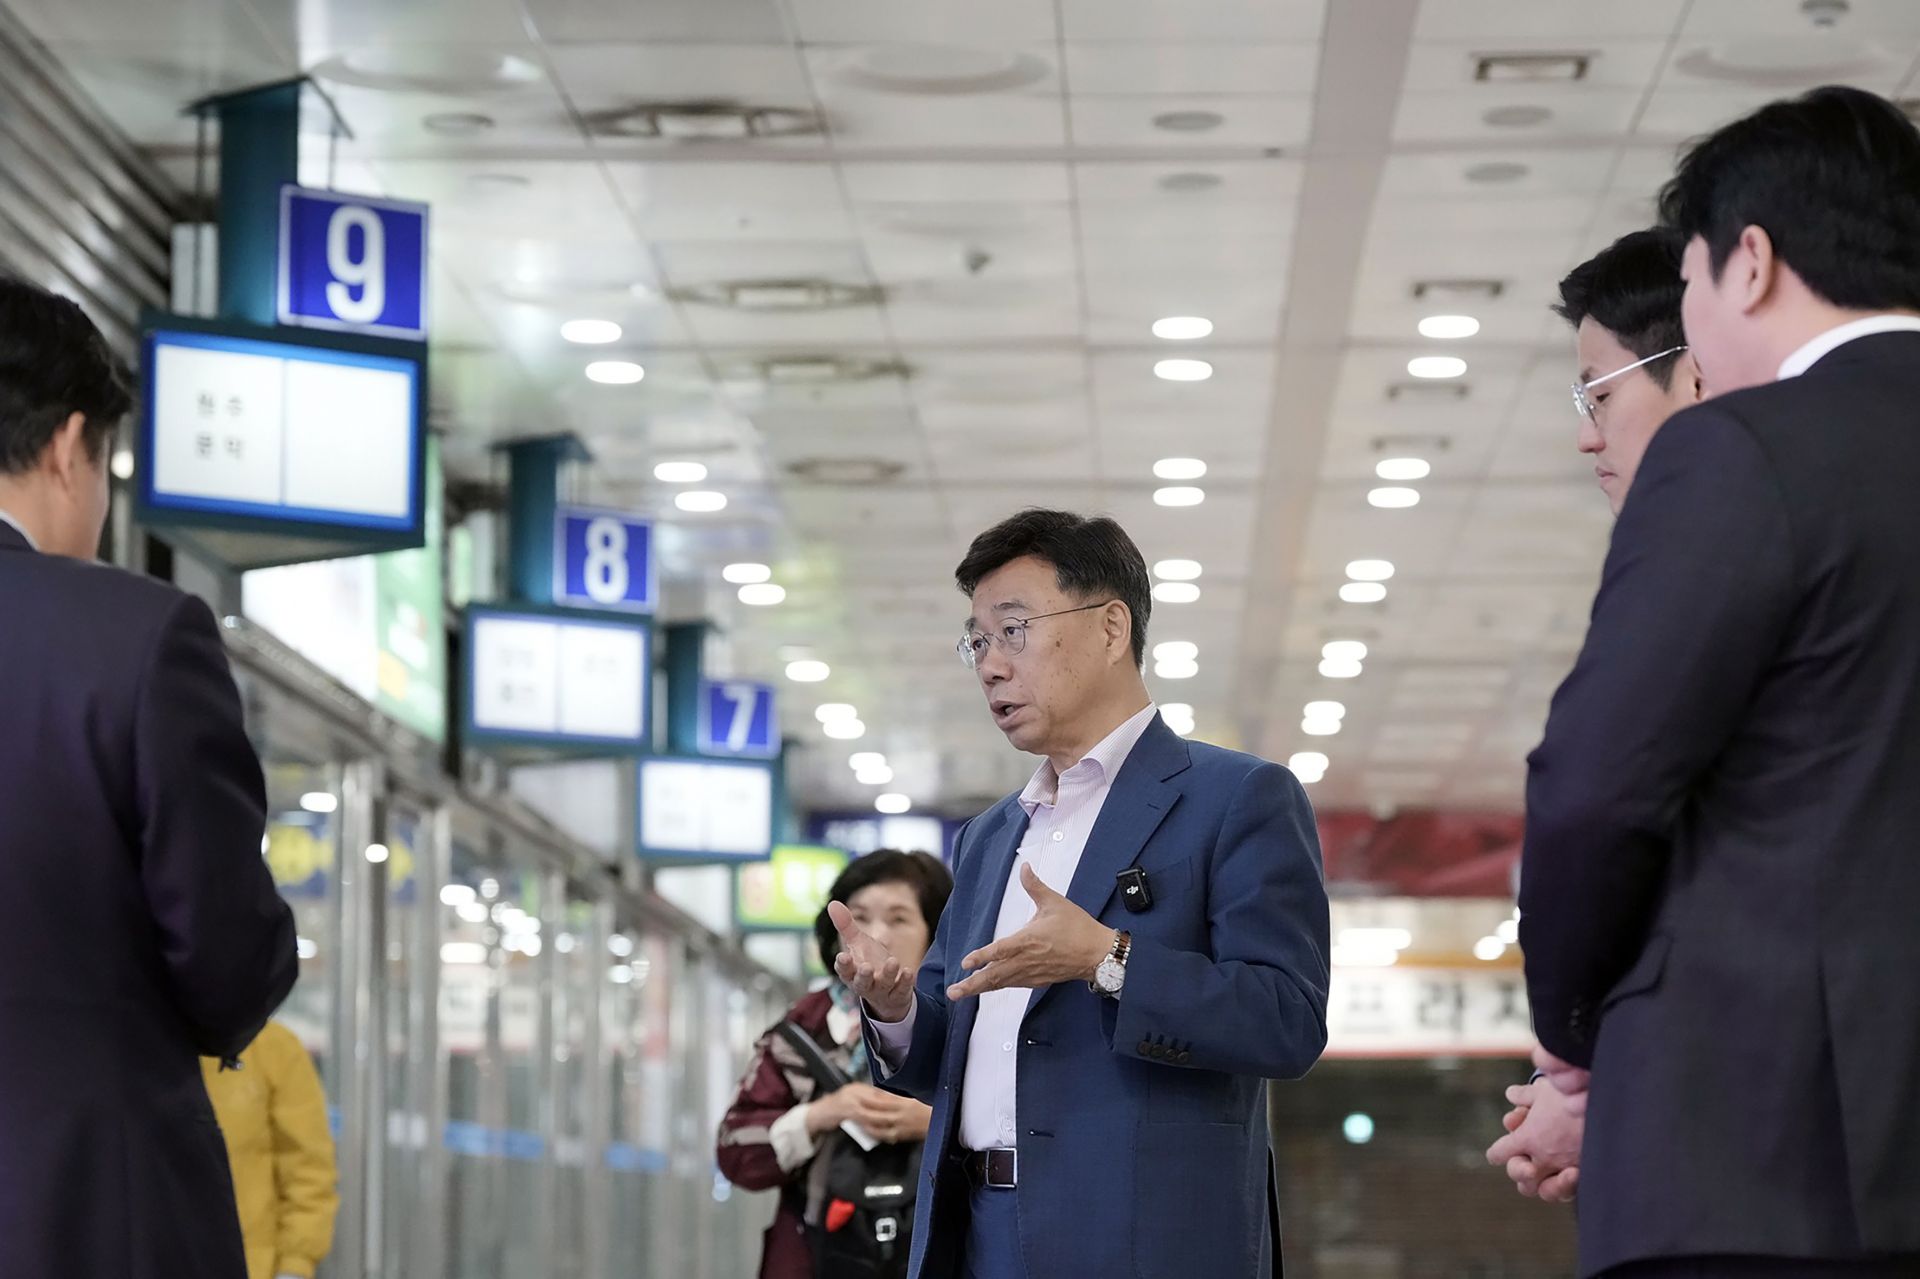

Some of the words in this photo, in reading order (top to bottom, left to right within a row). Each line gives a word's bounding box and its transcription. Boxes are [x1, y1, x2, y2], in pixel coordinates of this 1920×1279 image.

[326, 205, 386, 324] 9
[583, 516, 629, 605] 8
[723, 684, 758, 751] 7
